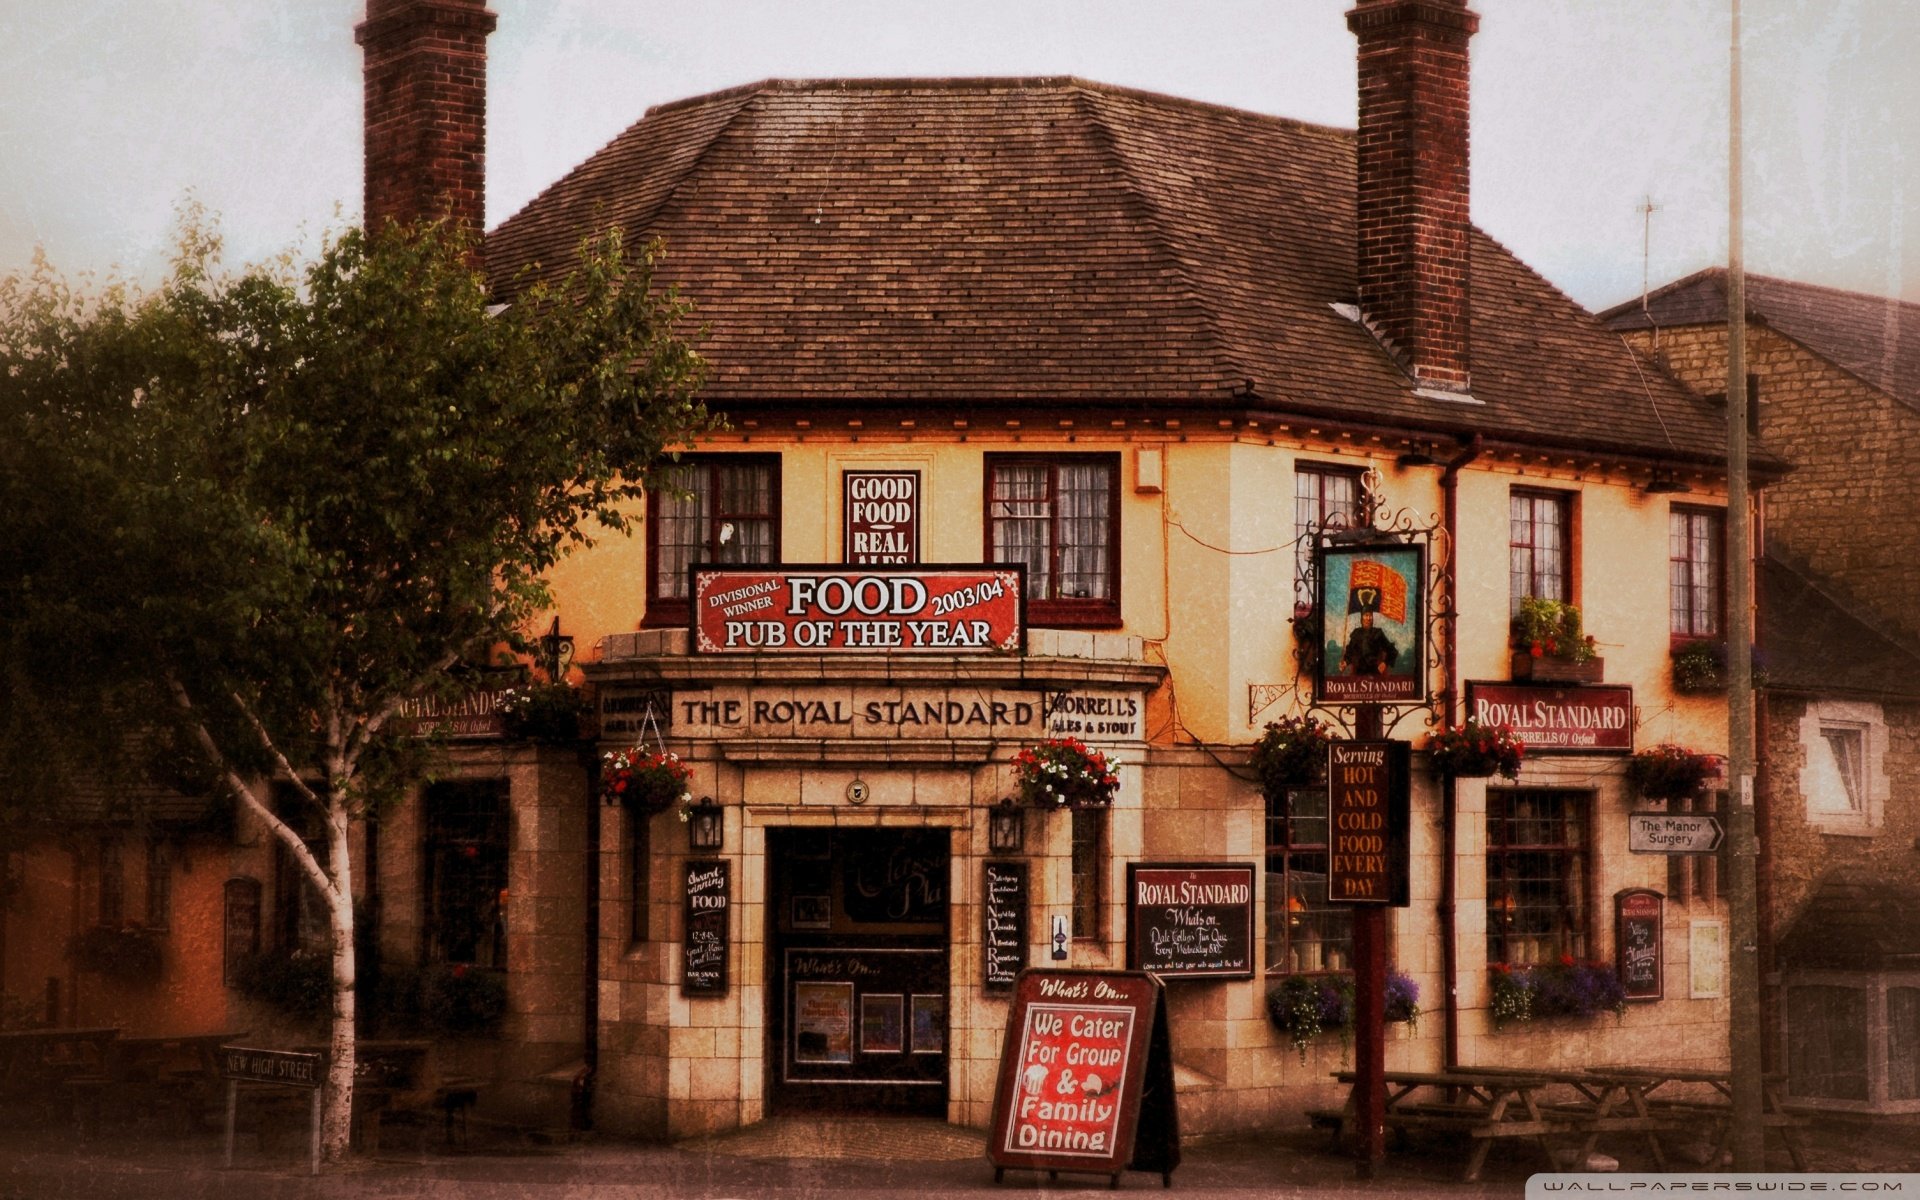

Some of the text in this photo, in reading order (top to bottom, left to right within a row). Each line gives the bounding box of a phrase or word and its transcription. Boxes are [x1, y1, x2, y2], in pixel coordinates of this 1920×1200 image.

[851, 478, 912, 500] GOOD
[852, 502, 911, 524] FOOD
[853, 532, 909, 553] REAL
[709, 579, 781, 607] DIVISIONAL
[787, 577, 927, 615] FOOD
[931, 580, 1004, 616] 2003/04
[723, 596, 773, 618] WINNER
[725, 621, 991, 647] PUB OF THE YEAR
[1326, 680, 1415, 693] ROYAL STANDARD
[682, 701, 742, 726] THE
[754, 700, 852, 725] ROYAL
[864, 701, 1034, 727] STANDARD
[1477, 698, 1625, 729] ROYAL STANDARD
[1086, 722, 1095, 733] &
[1097, 722, 1137, 734] STOUT
[1559, 732, 1569, 745] Of
[1572, 733, 1596, 745] Oxford
[1334, 746, 1384, 766] Serving
[1343, 767, 1376, 784] HOT
[1343, 790, 1378, 807] AND
[1338, 812, 1382, 830] COLD
[1640, 820, 1701, 832] The Manor
[1339, 835, 1383, 853] FOOD
[1649, 833, 1693, 845] Surgery
[1334, 855, 1386, 873] EVERY
[687, 876, 724, 895] winning
[1137, 881, 1249, 905] ROYAL STANDARD
[1344, 879, 1376, 895] DAY
[692, 895, 726, 908] FOOD
[1165, 906, 1205, 926] What's
[1155, 942, 1173, 959] Every
[794, 957, 841, 975] What's
[1040, 979, 1129, 999] What's On...
[1035, 1013, 1124, 1039] We Cater
[1028, 1040, 1121, 1066] For Group
[227, 1054, 313, 1080] NEW HIGH STREET
[1056, 1068, 1079, 1095] &
[1021, 1096, 1112, 1122] Family
[1019, 1124, 1105, 1150] Dining
